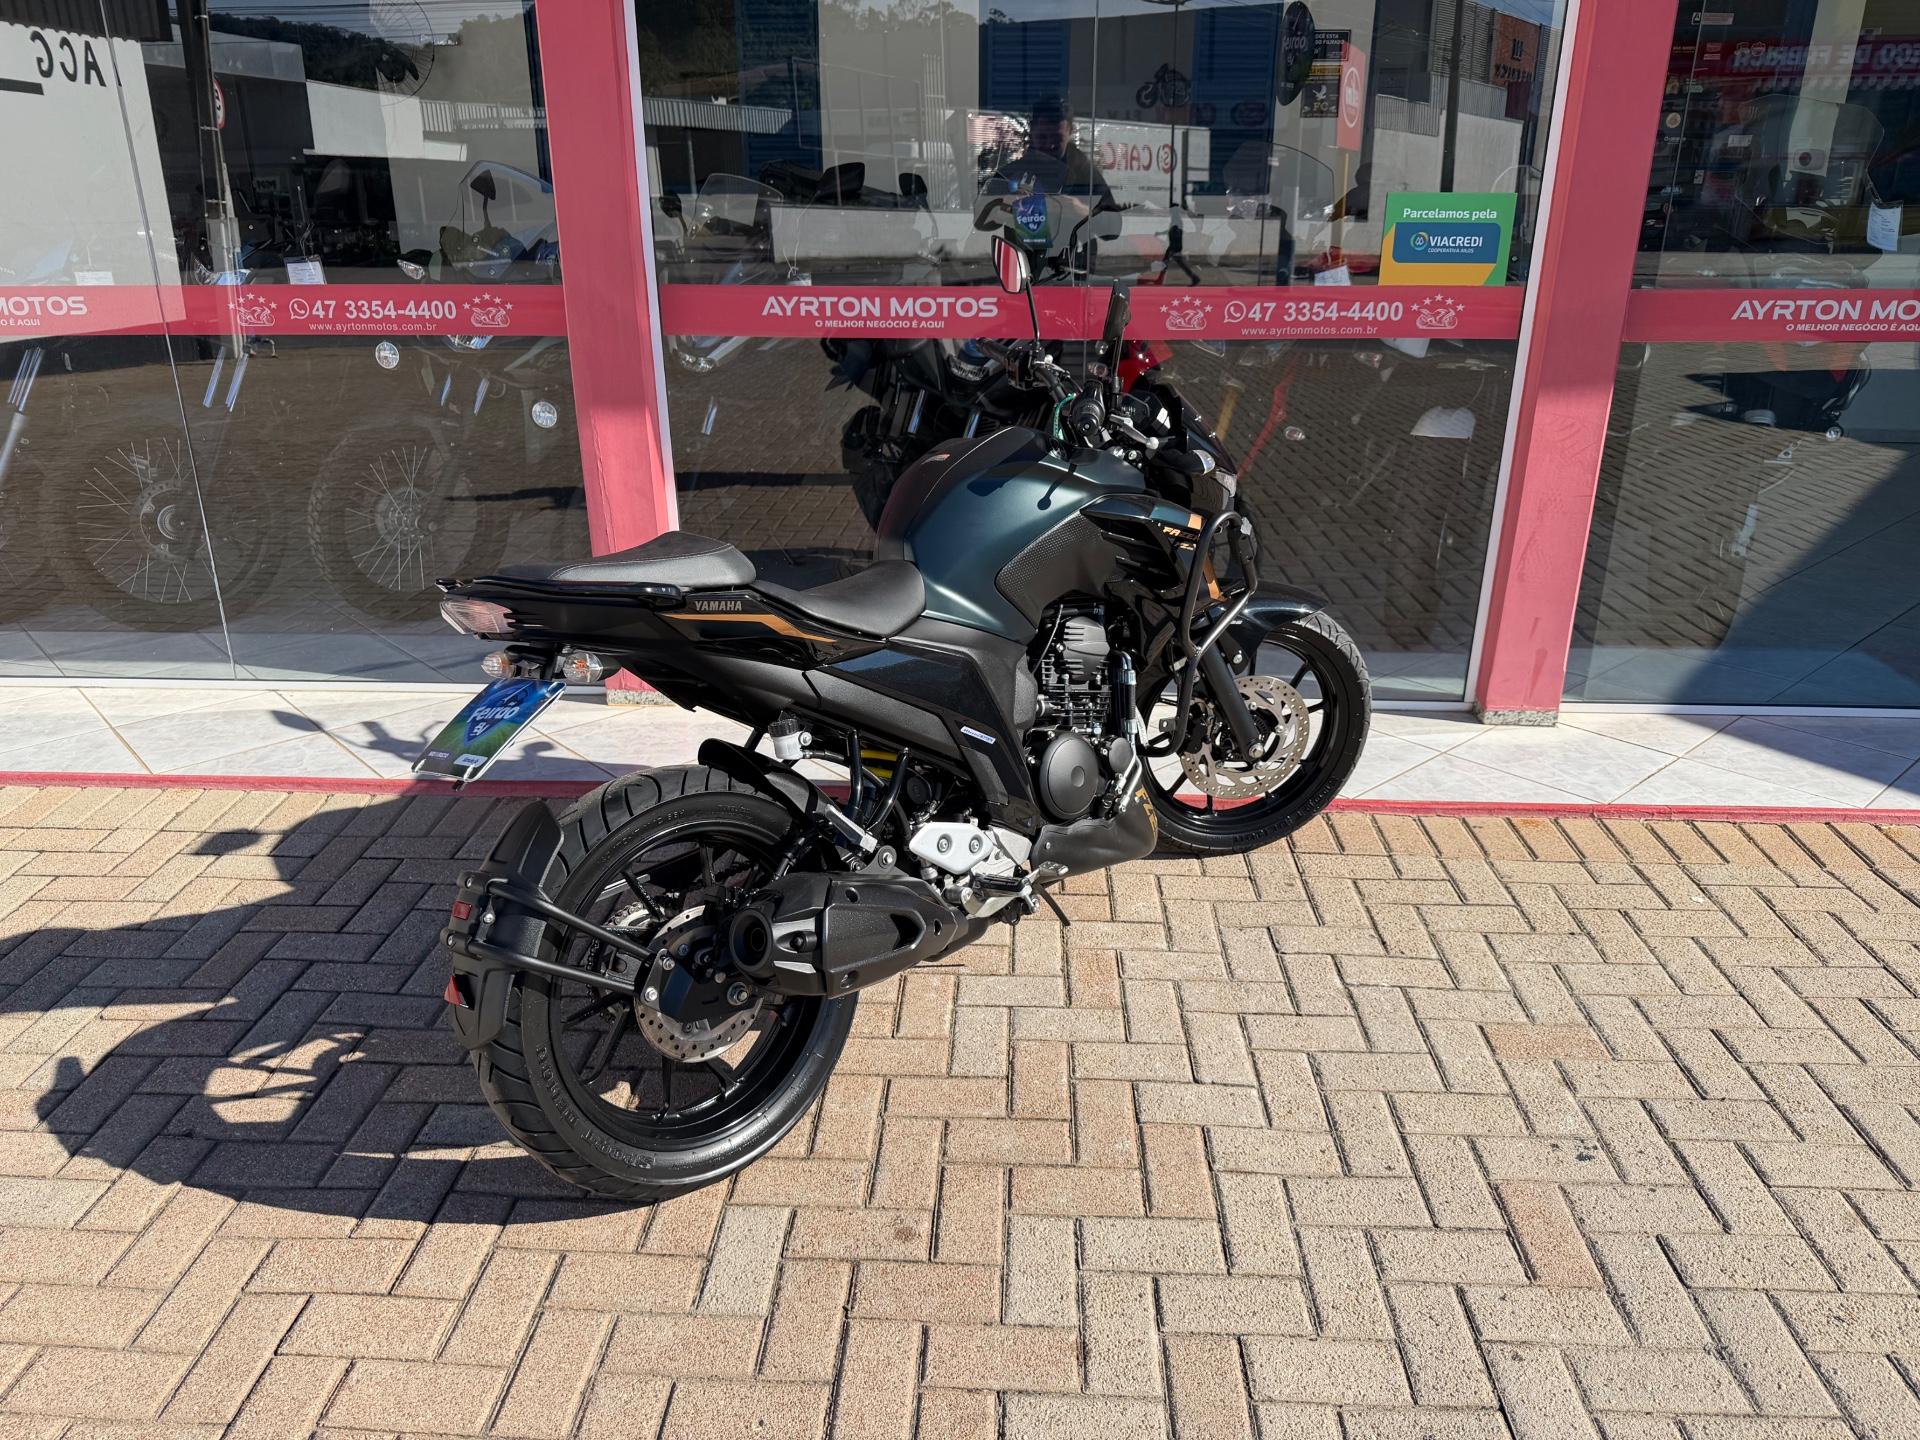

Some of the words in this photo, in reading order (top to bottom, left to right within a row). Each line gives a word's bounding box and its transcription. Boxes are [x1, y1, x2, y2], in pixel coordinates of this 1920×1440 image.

[1017, 213, 1046, 225] Feirão
[1403, 208, 1470, 219] Parcelamos
[1472, 208, 1497, 220] pela
[1429, 236, 1483, 247] VIACREDI
[312, 299, 336, 319] 47
[344, 299, 457, 320] 3354-4400
[761, 296, 881, 318] AYRTON
[890, 296, 999, 318] MOTOS
[1248, 301, 1277, 322] 47
[1283, 301, 1403, 322] 3354-4400
[1730, 299, 1862, 321] AYRTON
[17, 318, 41, 327] AQUI
[308, 321, 437, 332] www.ayrtonmotos.com.br
[815, 320, 823, 328] O
[825, 320, 864, 328] MELHOR
[866, 318, 910, 329] NEGÓCIO
[911, 318, 918, 329] É
[919, 320, 945, 329] AQUI
[1785, 323, 1795, 332] O
[1796, 323, 1839, 332] MELHOR
[1841, 321, 1889, 332] NEGÓCIO
[1890, 321, 1897, 332] É
[1240, 325, 1378, 337] www.ayrtonmotos.com.br
[695, 600, 742, 611] YAMAHA
[466, 701, 520, 723] Feirão
